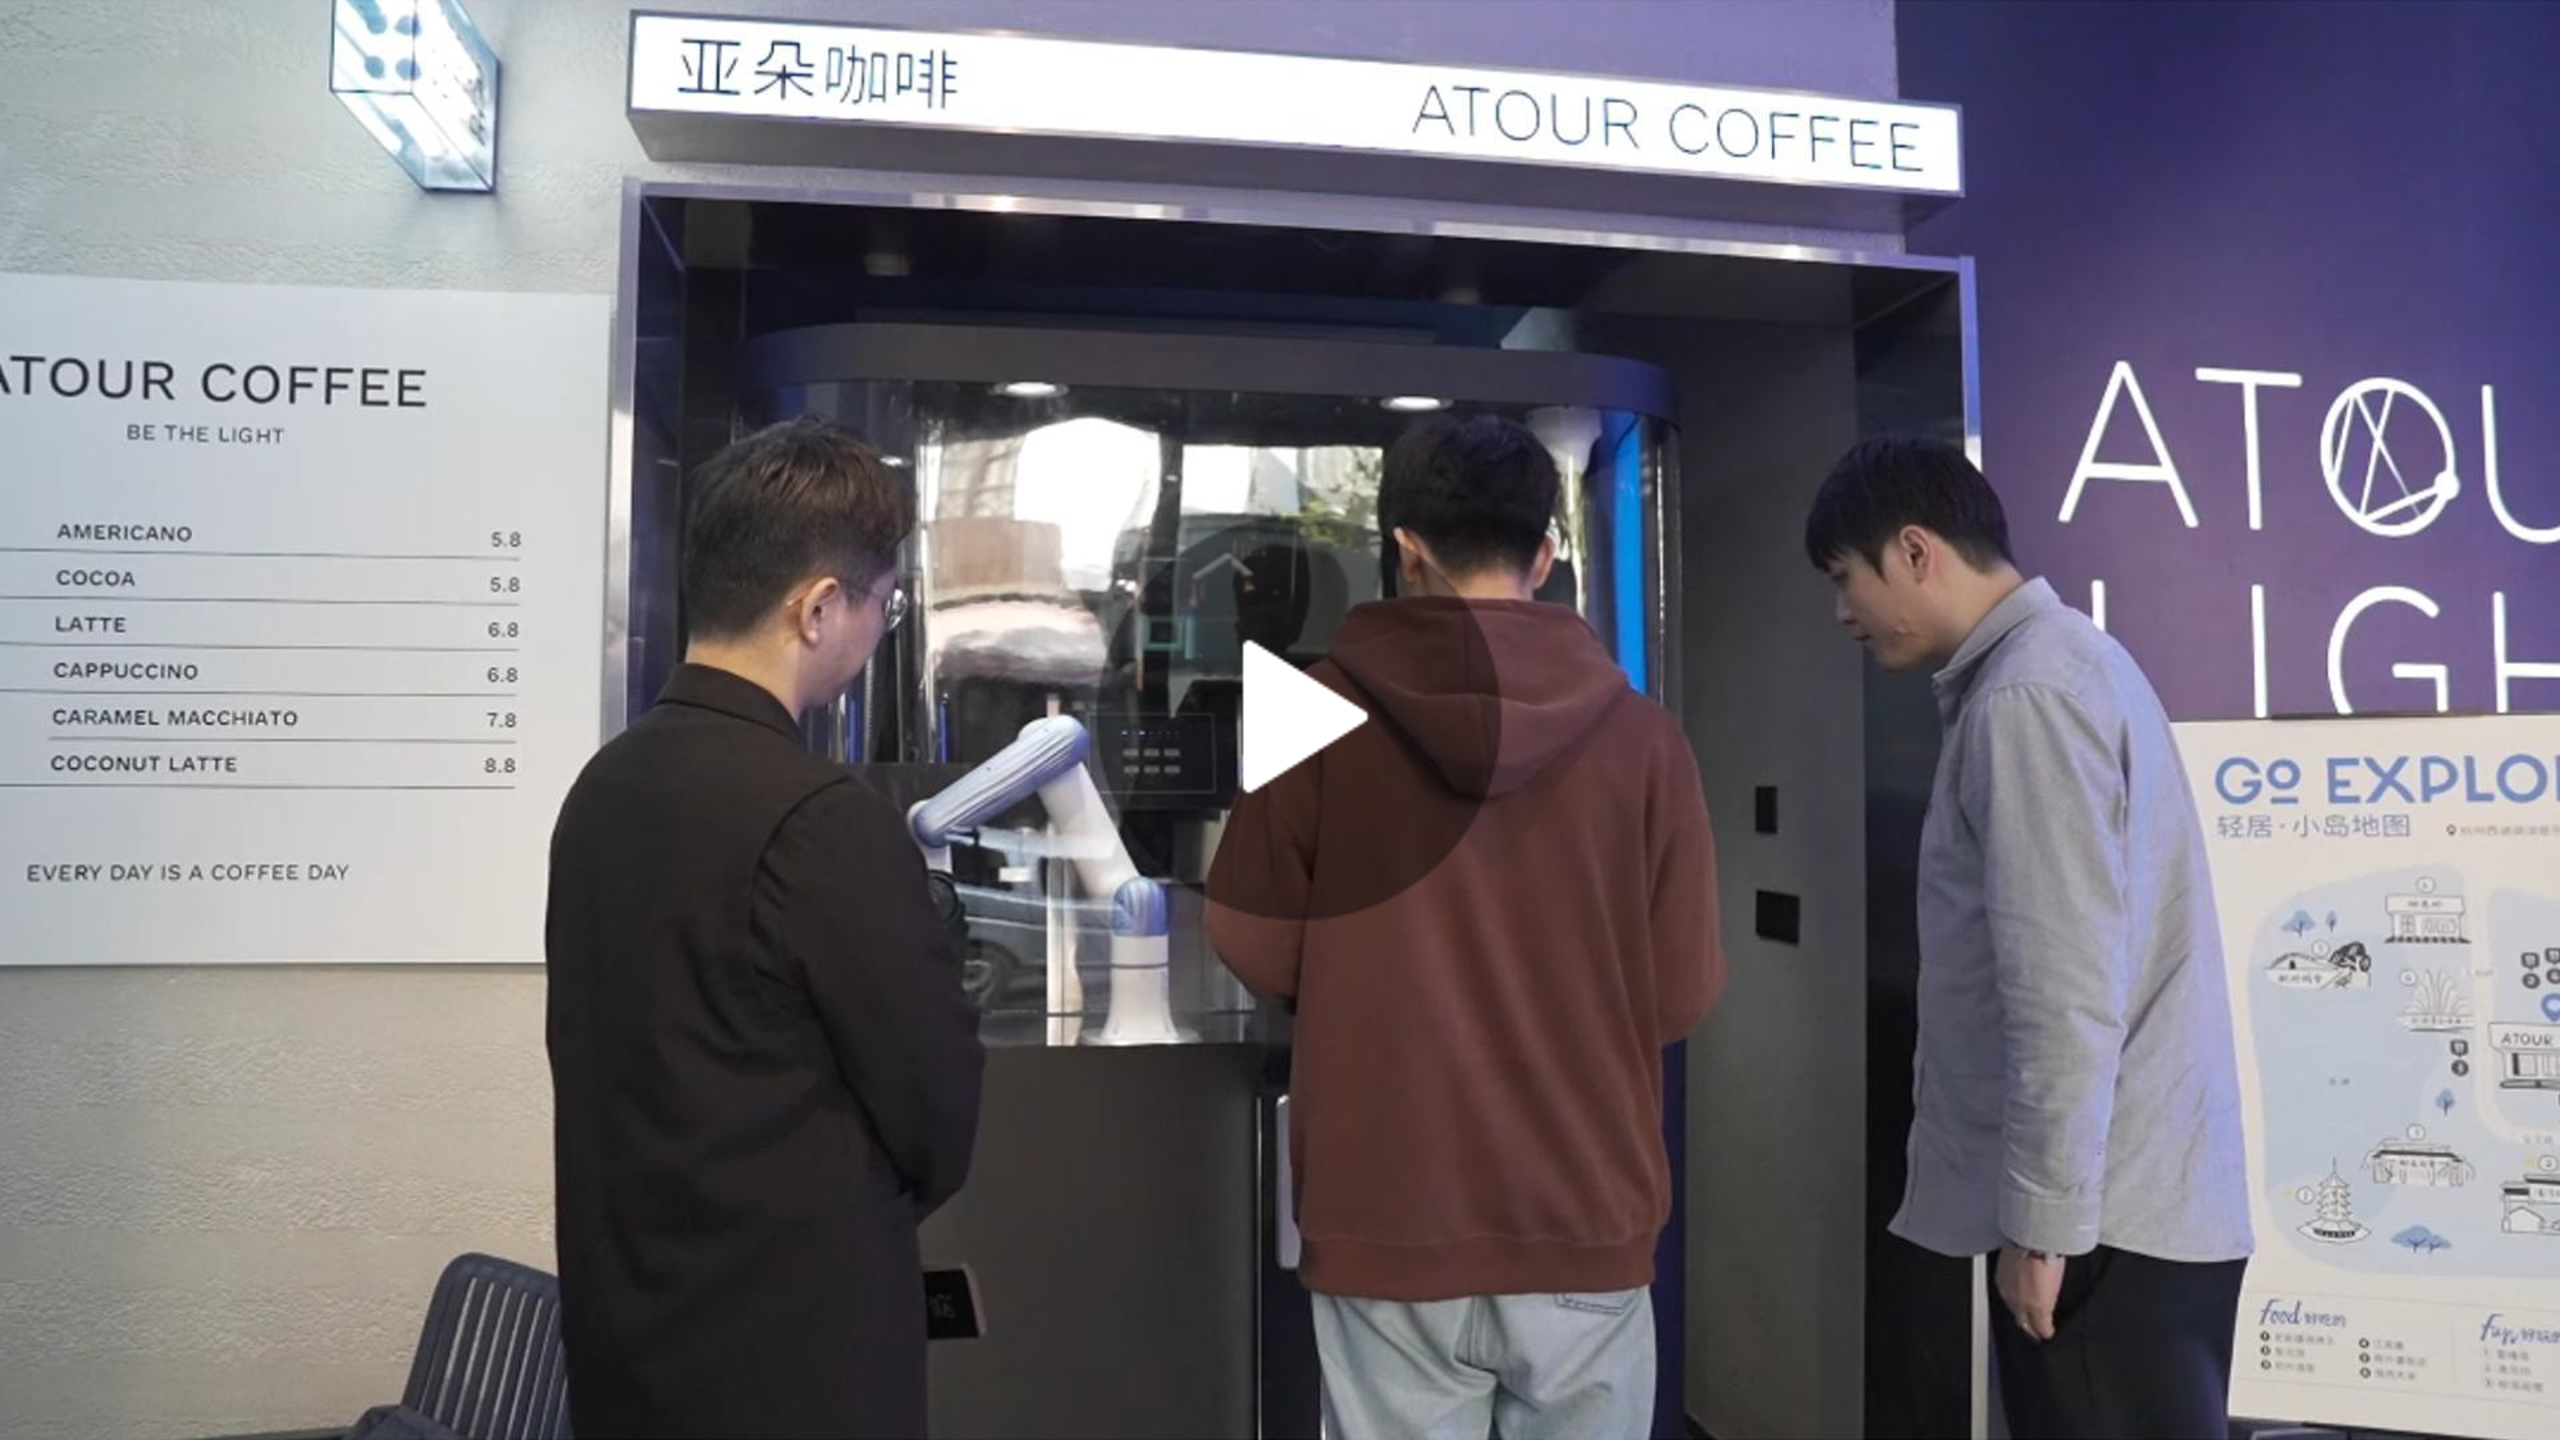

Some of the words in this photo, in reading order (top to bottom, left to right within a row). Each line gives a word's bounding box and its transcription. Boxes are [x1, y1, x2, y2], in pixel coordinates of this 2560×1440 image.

[676, 37, 959, 110] 亚朵咖啡
[1411, 84, 1641, 149] ATOUR
[1668, 103, 1924, 173] COFFEE
[201, 362, 428, 408] COFFEE
[126, 423, 156, 441] BE
[164, 424, 209, 443] THE
[218, 426, 285, 444] LIGHT
[57, 523, 193, 543] AMERICANO
[491, 531, 522, 548] 5.8
[56, 569, 136, 588] COCOA
[490, 576, 521, 593] 5.8
[54, 615, 127, 634] LATTE
[487, 621, 520, 639] 6.8
[53, 661, 199, 681] CAPPUCCINO
[486, 666, 519, 684] 6.8
[52, 708, 161, 726] CARAMEL
[167, 709, 299, 727] MACCHIATO
[486, 711, 517, 729] 7.8
[50, 754, 161, 773] COCONUT
[168, 755, 238, 773] LATTE
[484, 756, 517, 774] 8.8
[2215, 756, 2302, 805] Go
[2326, 753, 2560, 805] EXPLO
[27, 863, 103, 883] EVERY
[109, 863, 154, 882] DAY
[160, 863, 182, 882] IS
[188, 864, 204, 881] A
[211, 863, 299, 882] COFFEE
[307, 863, 350, 882] DAY
[2501, 1032, 2554, 1047] ATOUR
[2258, 1297, 2303, 1326] food
